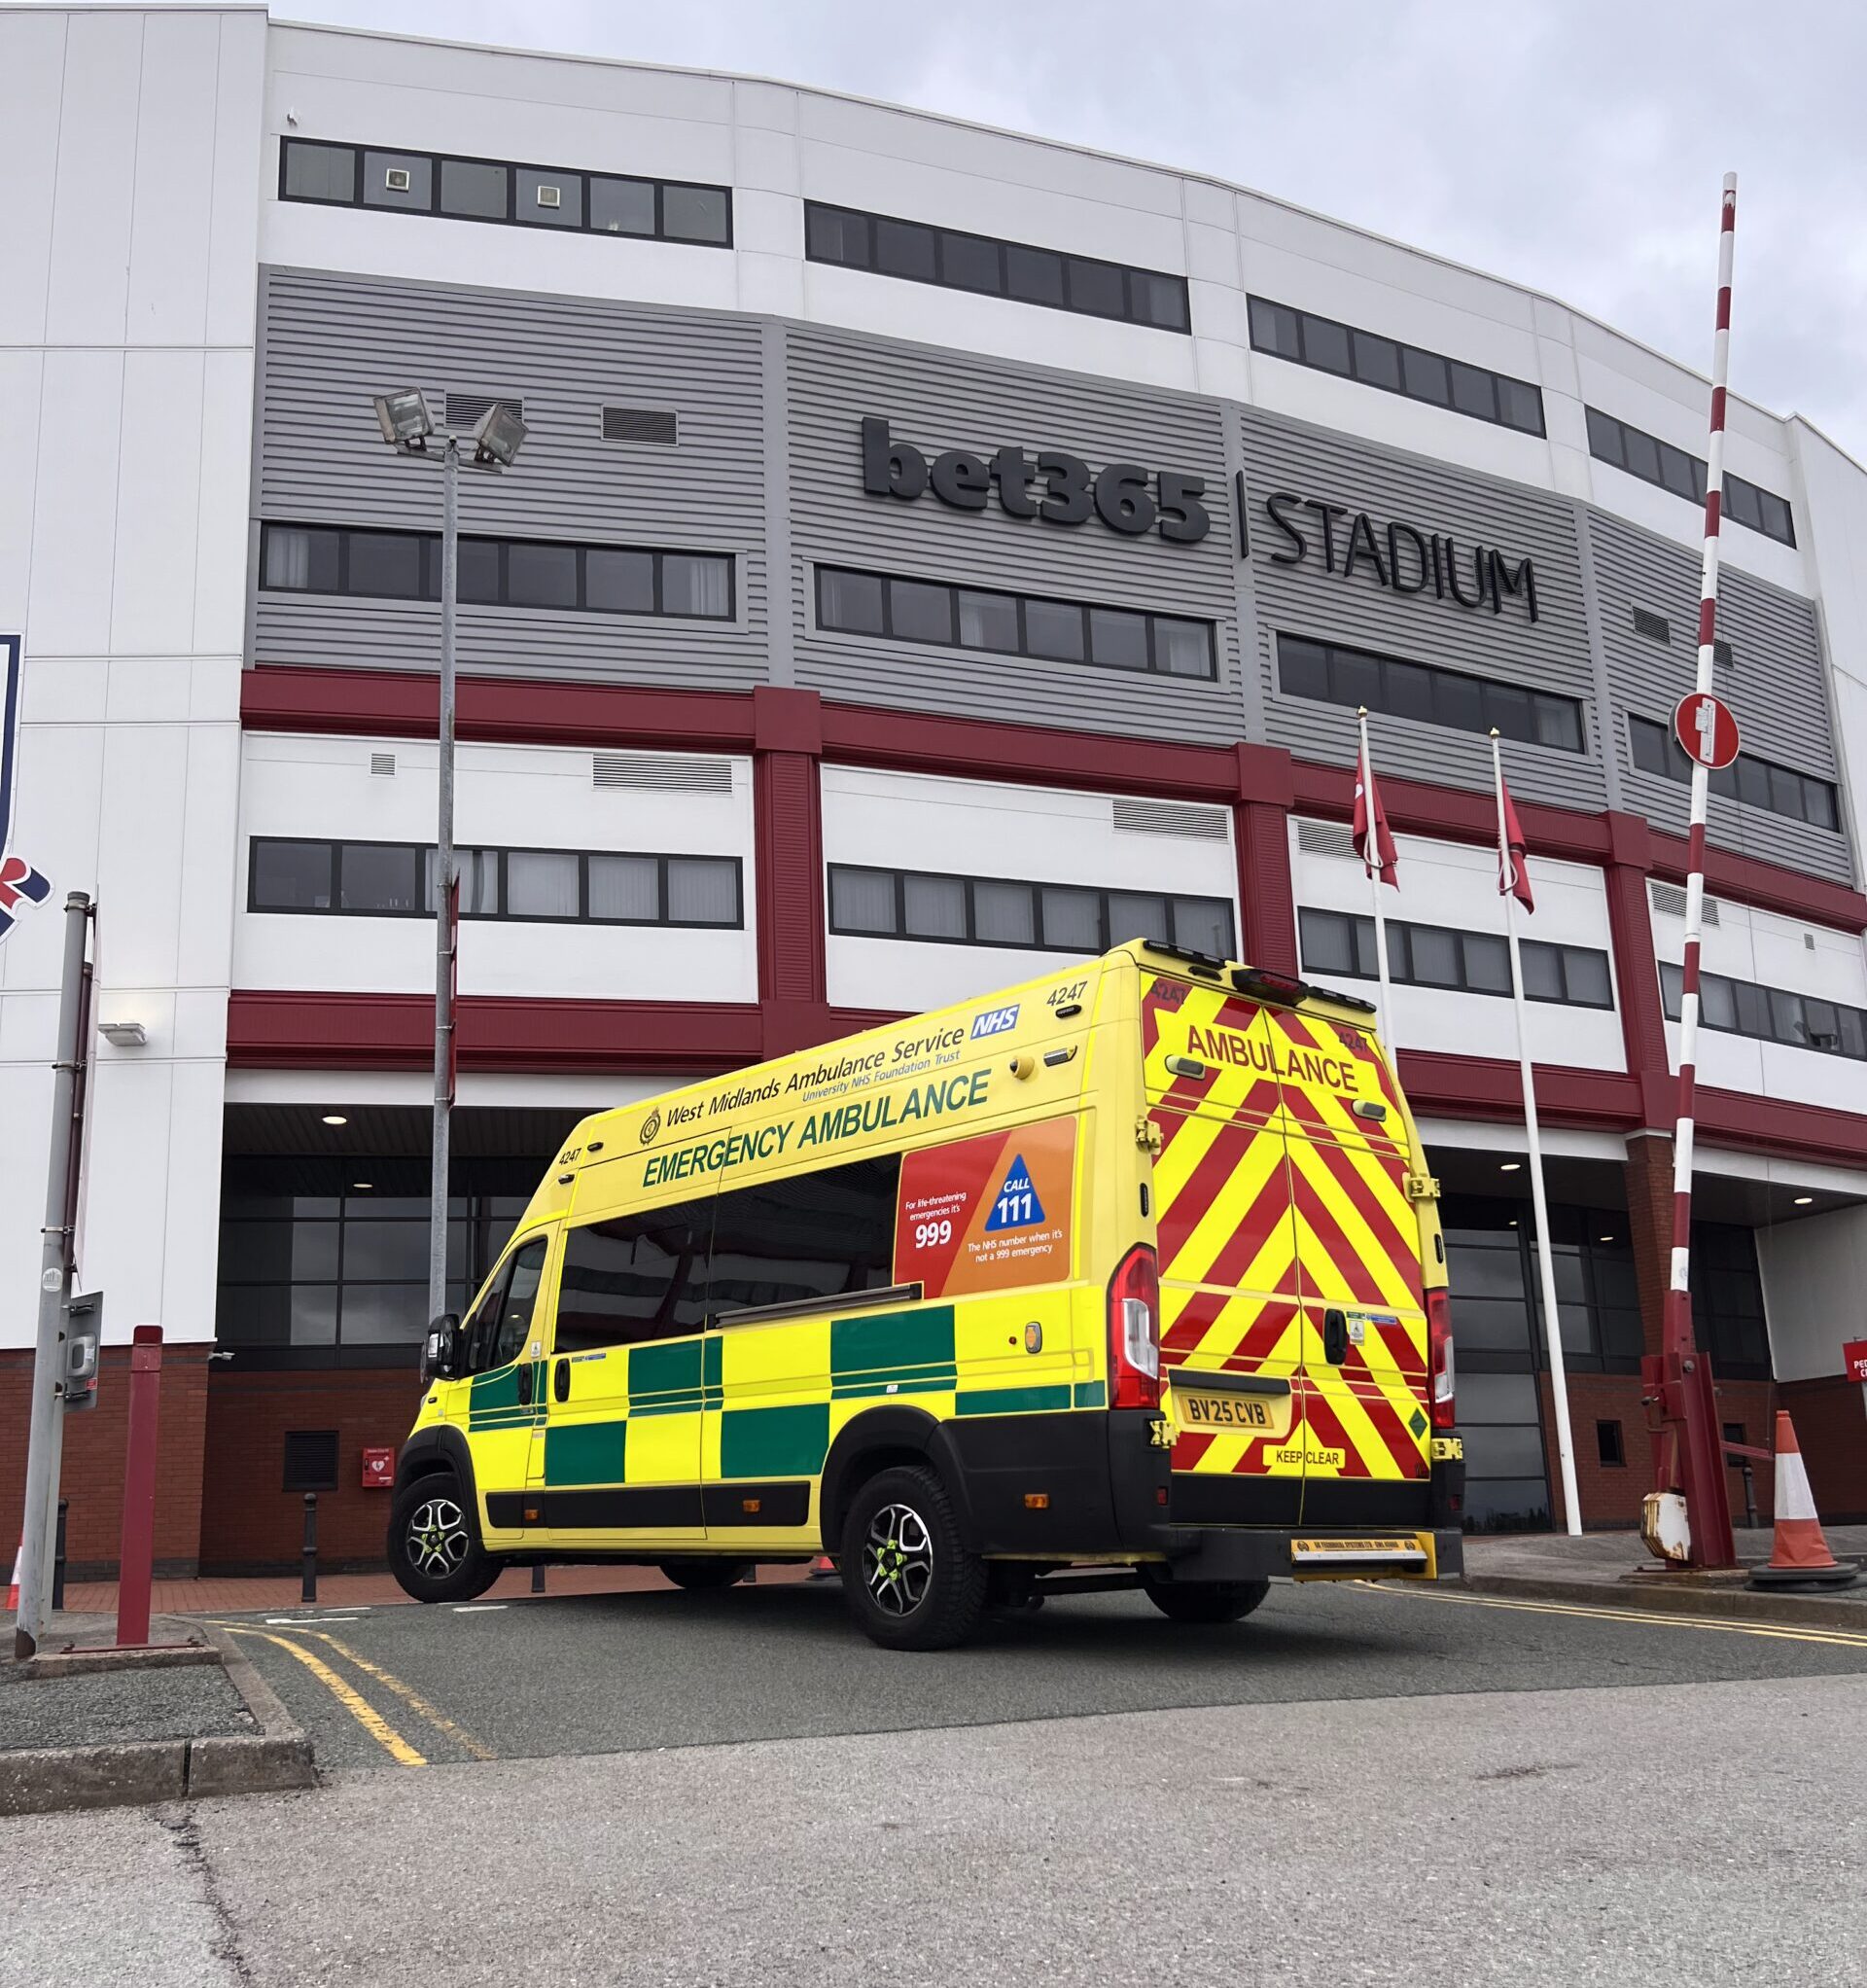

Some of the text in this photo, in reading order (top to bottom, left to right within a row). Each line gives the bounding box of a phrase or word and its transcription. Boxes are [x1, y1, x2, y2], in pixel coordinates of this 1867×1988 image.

[862, 416, 1540, 623] bet365 STADIUM
[1046, 980, 1088, 1007] 4247
[971, 1005, 1020, 1038] NHS
[1187, 1024, 1359, 1093] AMBULANCE
[667, 1027, 965, 1127] West Midlands Ambulance Service
[802, 1050, 961, 1102] University NHS Foundation Trust
[643, 1068, 992, 1188] EMERGENCY AMBULANCE
[559, 1147, 581, 1165] 4247
[1004, 1177, 1031, 1193] CALL
[905, 1191, 967, 1211] For life-threatening
[909, 1207, 950, 1221] emergencies
[997, 1192, 1032, 1224] 111
[915, 1220, 952, 1249] 999
[968, 1243, 980, 1253] The
[982, 1240, 997, 1250] NHS
[999, 1235, 1027, 1247] number
[1029, 1231, 1050, 1242] when
[975, 1253, 987, 1262] not
[996, 1249, 1009, 1260] 999
[1011, 1244, 1052, 1257] emergency
[1188, 1399, 1266, 1425] BV25 CVB
[1277, 1450, 1340, 1465] KEEP CLEAR
